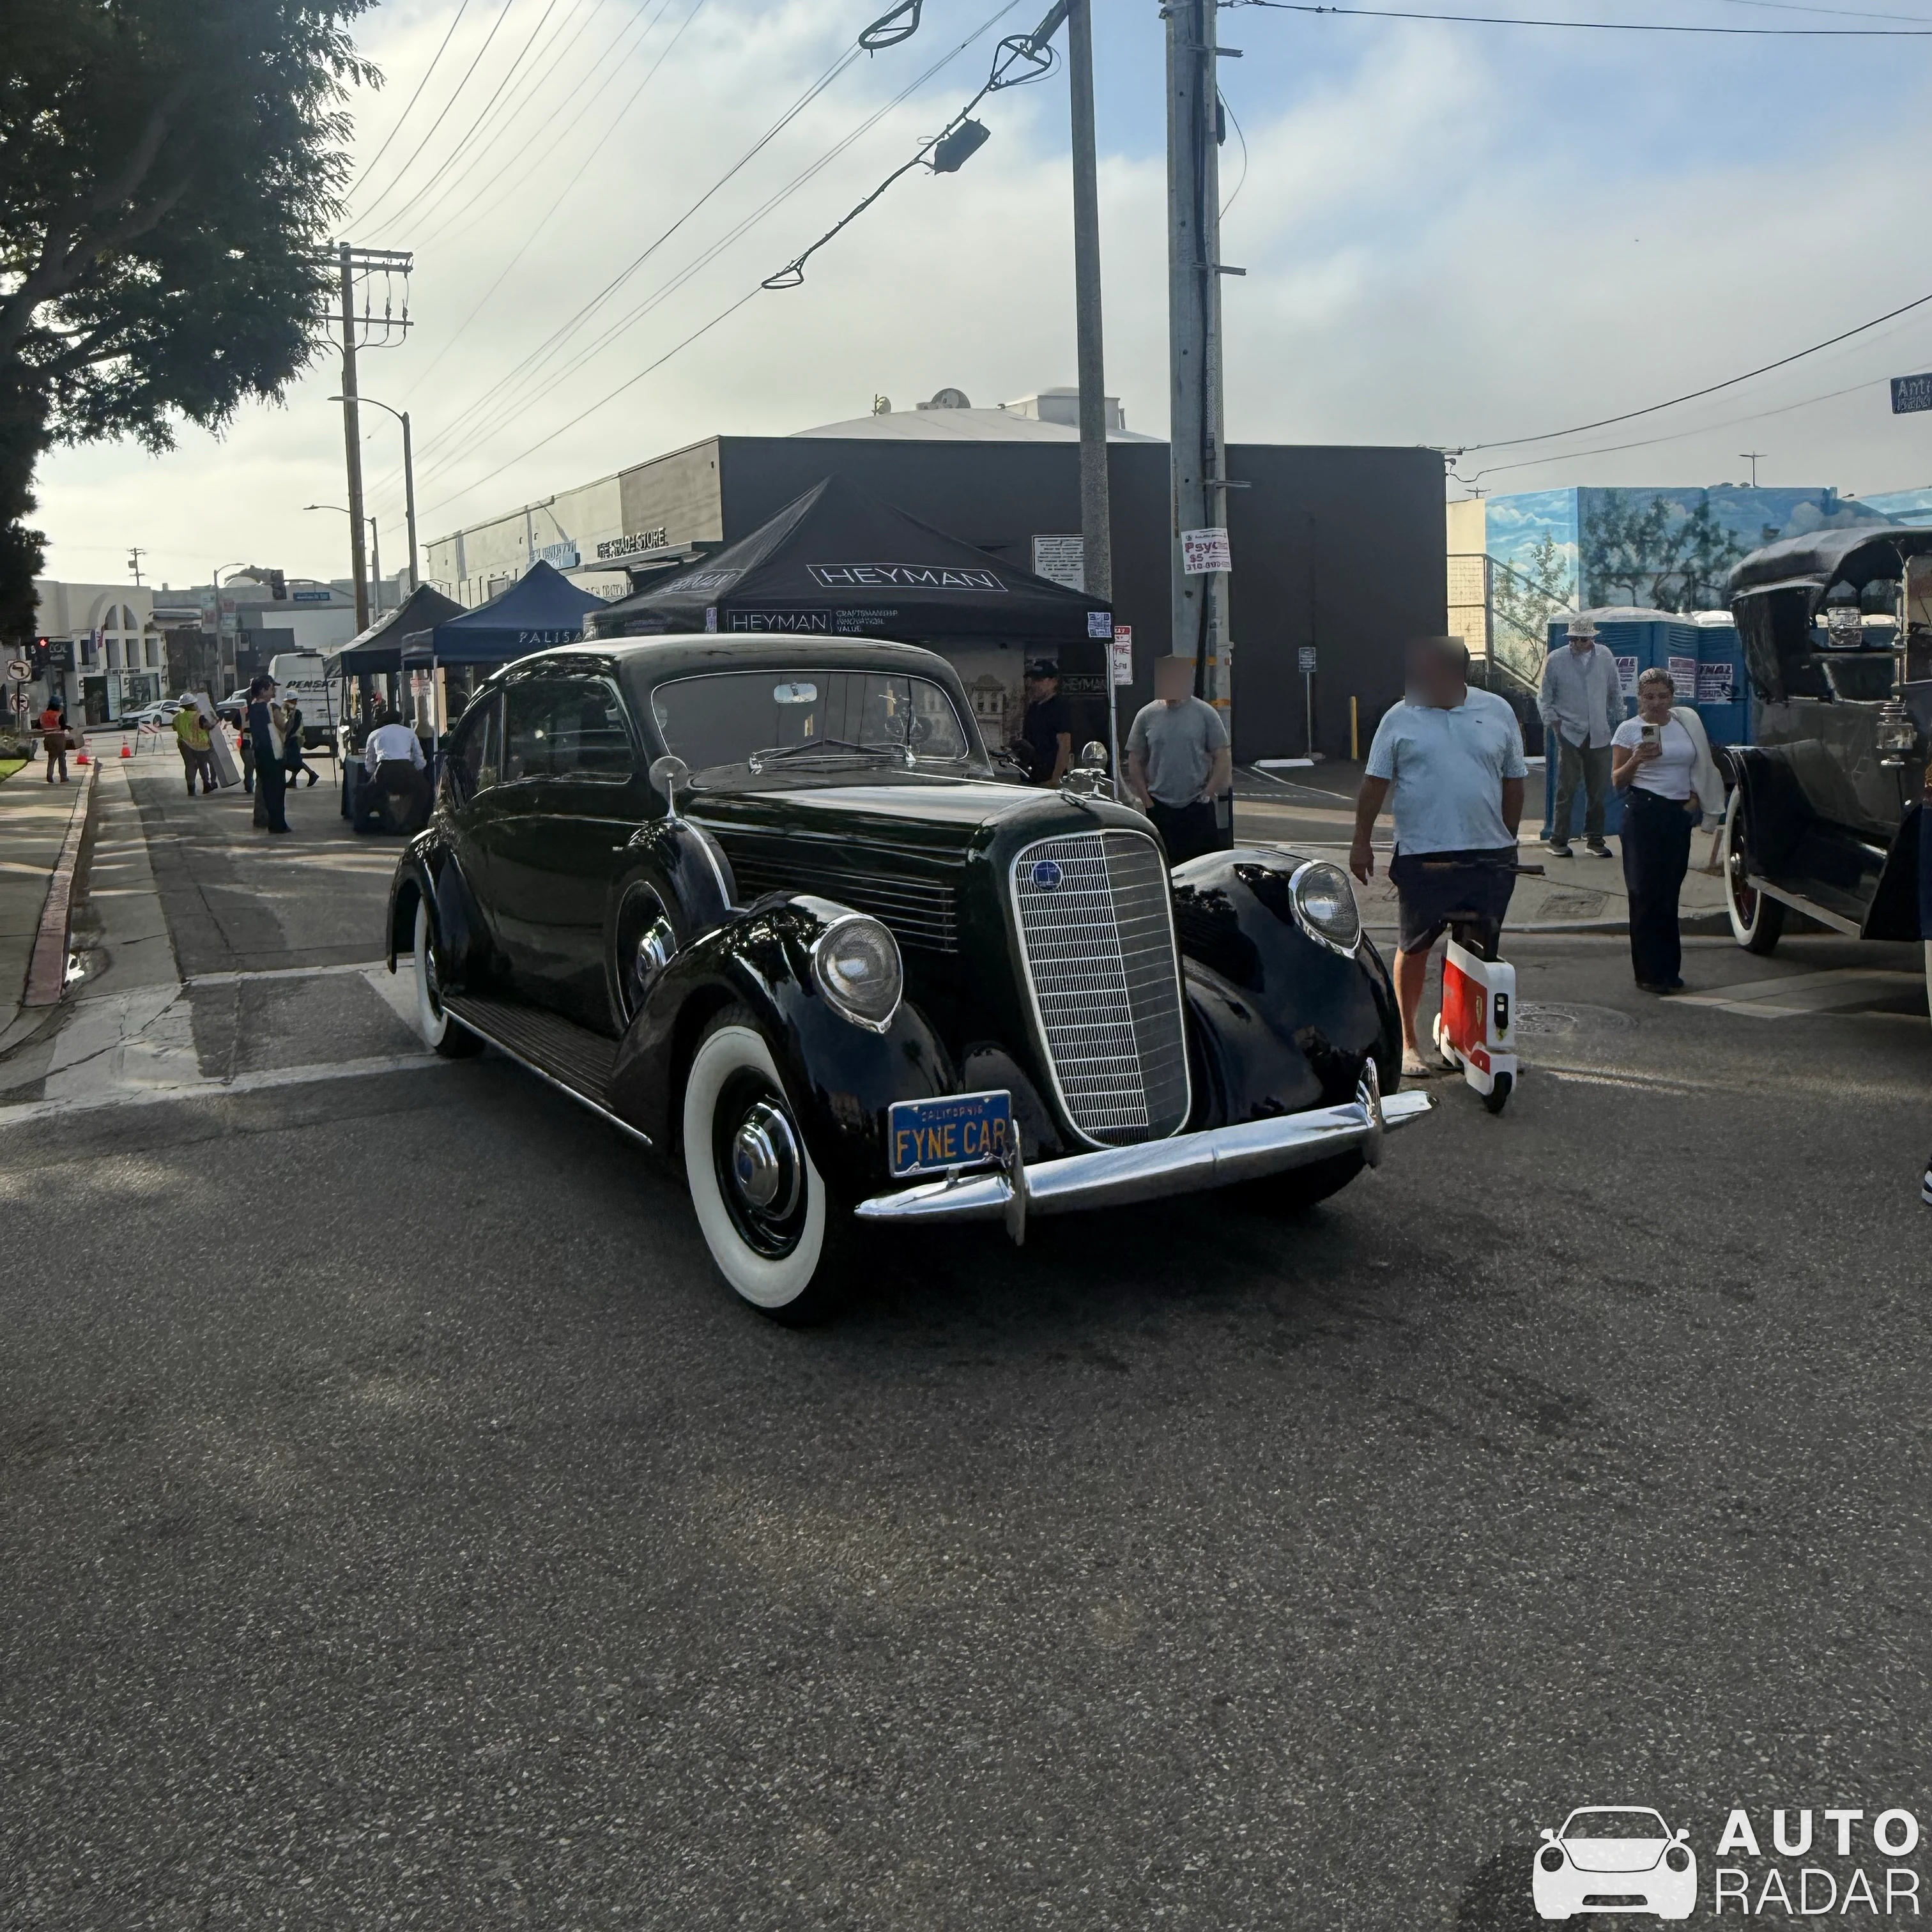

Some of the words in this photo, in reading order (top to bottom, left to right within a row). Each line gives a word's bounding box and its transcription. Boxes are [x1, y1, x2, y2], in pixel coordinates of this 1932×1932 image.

[820, 567, 994, 588] HEYMAN
[733, 614, 826, 631] HEYMAN
[921, 1104, 983, 1123] CALIFORNIA
[897, 1123, 957, 1165] FYNE
[963, 1118, 1006, 1154] CAR
